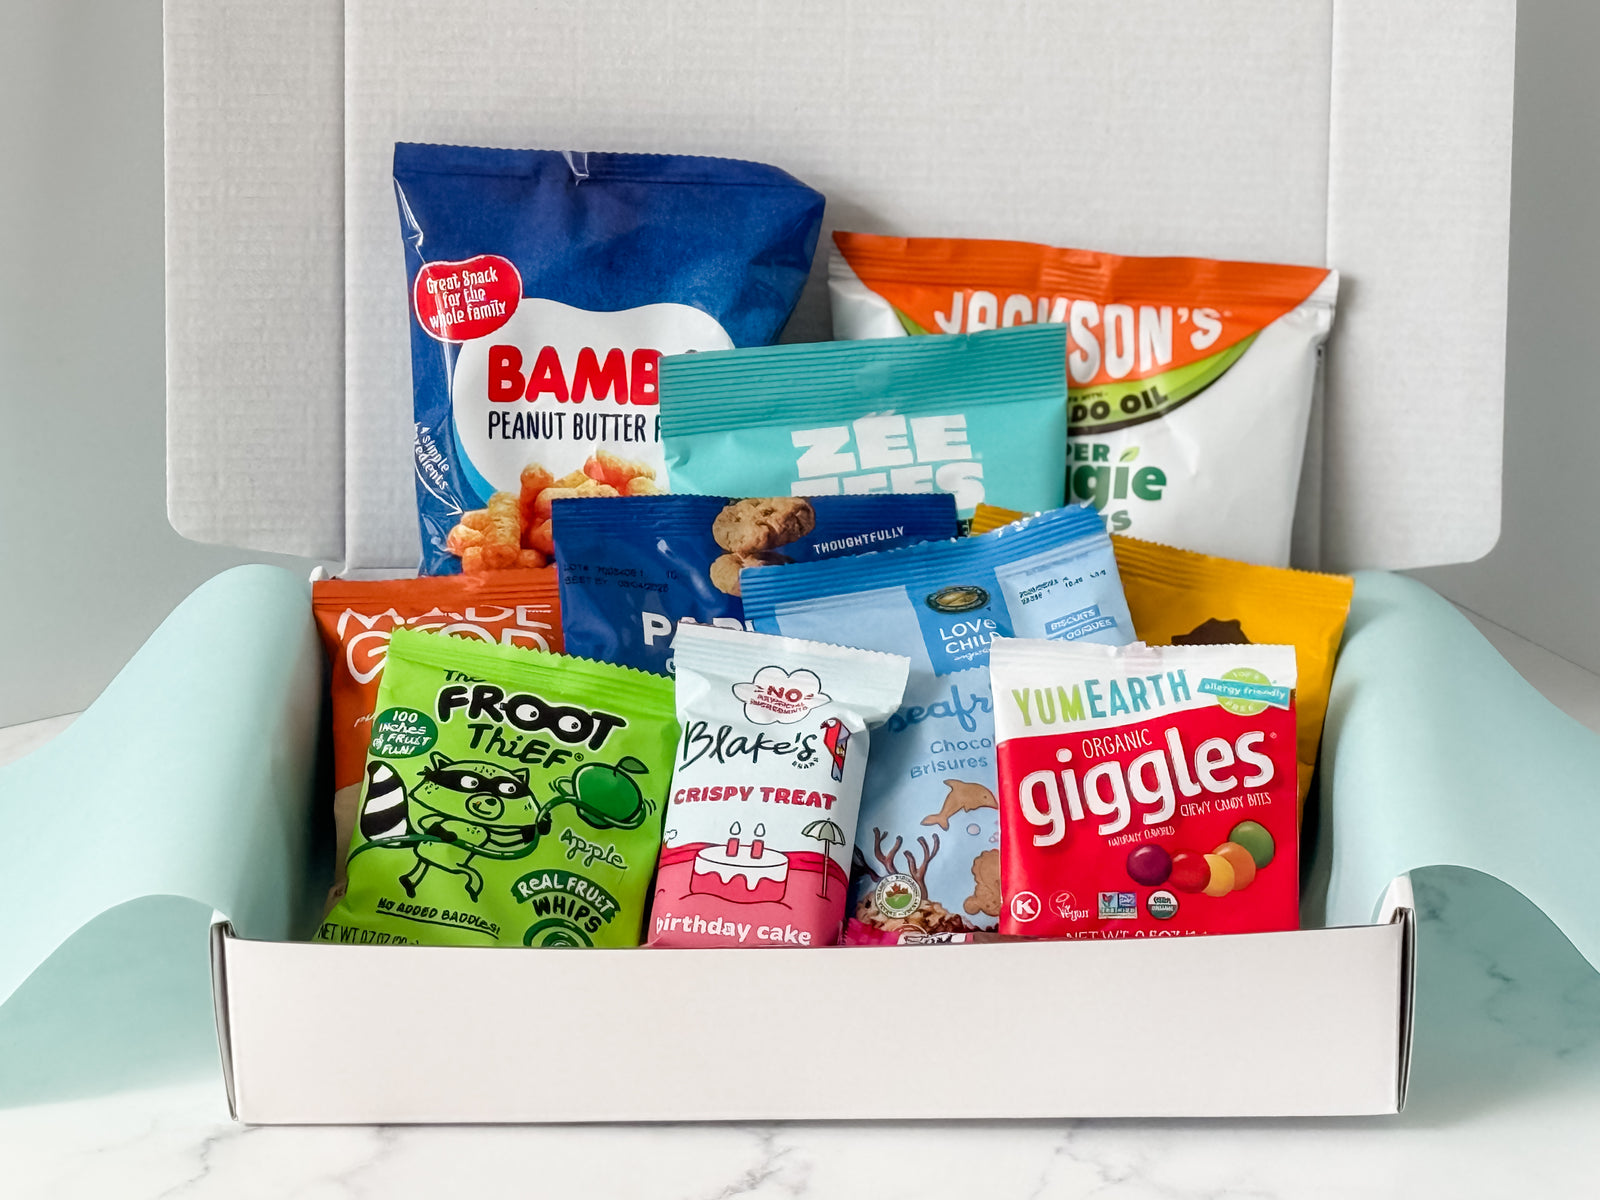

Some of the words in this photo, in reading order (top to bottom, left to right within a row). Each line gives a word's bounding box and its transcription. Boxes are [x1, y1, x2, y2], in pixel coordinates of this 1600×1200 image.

[426, 273, 460, 294] Great
[462, 266, 498, 286] Snack
[442, 291, 460, 309] for
[463, 285, 486, 304] the
[428, 307, 465, 329] whole
[466, 299, 506, 321] family
[488, 344, 663, 405] BAMB
[1120, 386, 1169, 415] OIL
[488, 411, 567, 440] PEANUT
[573, 413, 646, 442] BUTTER
[422, 435, 450, 473] simple
[812, 525, 906, 555] THOUGHTFULLY
[443, 669, 486, 682] The
[766, 685, 803, 703] NO
[1011, 668, 1192, 727] YUMEARTH
[1204, 682, 1241, 696] allergy
[1243, 686, 1286, 701] friendly
[392, 710, 418, 723] 100
[437, 685, 627, 751] FROOT
[381, 743, 416, 755] FUN!
[678, 720, 818, 772] Blake's
[930, 738, 992, 754] Choco
[1082, 728, 1153, 760] ORGANIC
[674, 786, 754, 805] CRISPY
[760, 786, 838, 811] TREAT
[1018, 726, 1275, 848] giggles
[1180, 800, 1212, 817] CHEWY
[1214, 796, 1244, 812] CANDY
[1247, 792, 1272, 808] BITES
[560, 828, 628, 869] Apple
[377, 898, 398, 910] NO
[396, 905, 439, 920] ADDED
[532, 894, 602, 933] WHIPS
[317, 922, 338, 941] NET
[340, 925, 360, 942] WT
[656, 912, 751, 942] birthday
[756, 924, 812, 945] cake
